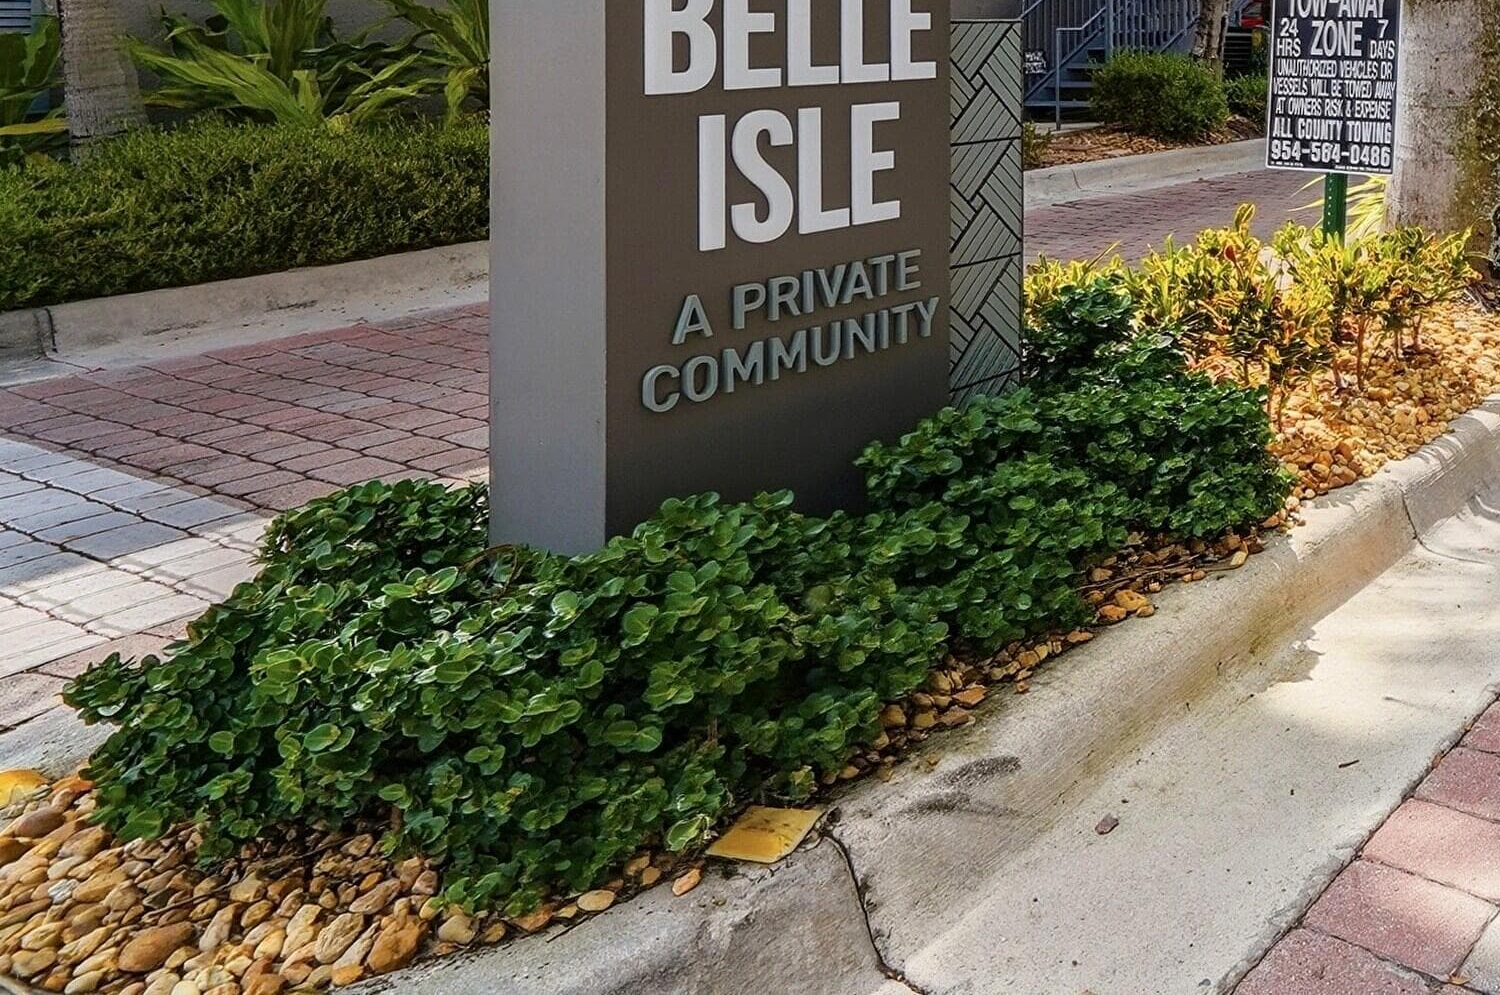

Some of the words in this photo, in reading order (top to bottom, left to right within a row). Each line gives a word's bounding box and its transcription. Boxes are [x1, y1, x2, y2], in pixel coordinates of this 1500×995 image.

[1280, 17, 1299, 37] 24
[1310, 19, 1363, 57] ZONE
[1378, 19, 1389, 38] 7
[1276, 38, 1302, 57] HRS
[1369, 40, 1395, 59] DAYS
[1277, 59, 1338, 78] UNAUTHORIZED
[1340, 60, 1379, 80] VEHICLES
[1380, 61, 1393, 80] OR
[1273, 77, 1308, 96] VESSELS
[1311, 79, 1329, 97] WILL
[1331, 79, 1343, 97] BE
[1344, 80, 1373, 98] TOWED
[1374, 81, 1396, 99] AWAY
[1275, 97, 1286, 114] AT
[1324, 98, 1344, 117] RISK
[1345, 100, 1352, 117] &
[1354, 100, 1392, 120] EXPENSE
[1272, 117, 1293, 138] ALL
[1297, 118, 1343, 141] COUNTY
[1346, 120, 1392, 143] TOWING
[698, 101, 901, 252] ISLE
[671, 293, 713, 345] A
[732, 249, 922, 330] PRIVATE
[641, 297, 939, 413] COMMUNITY
